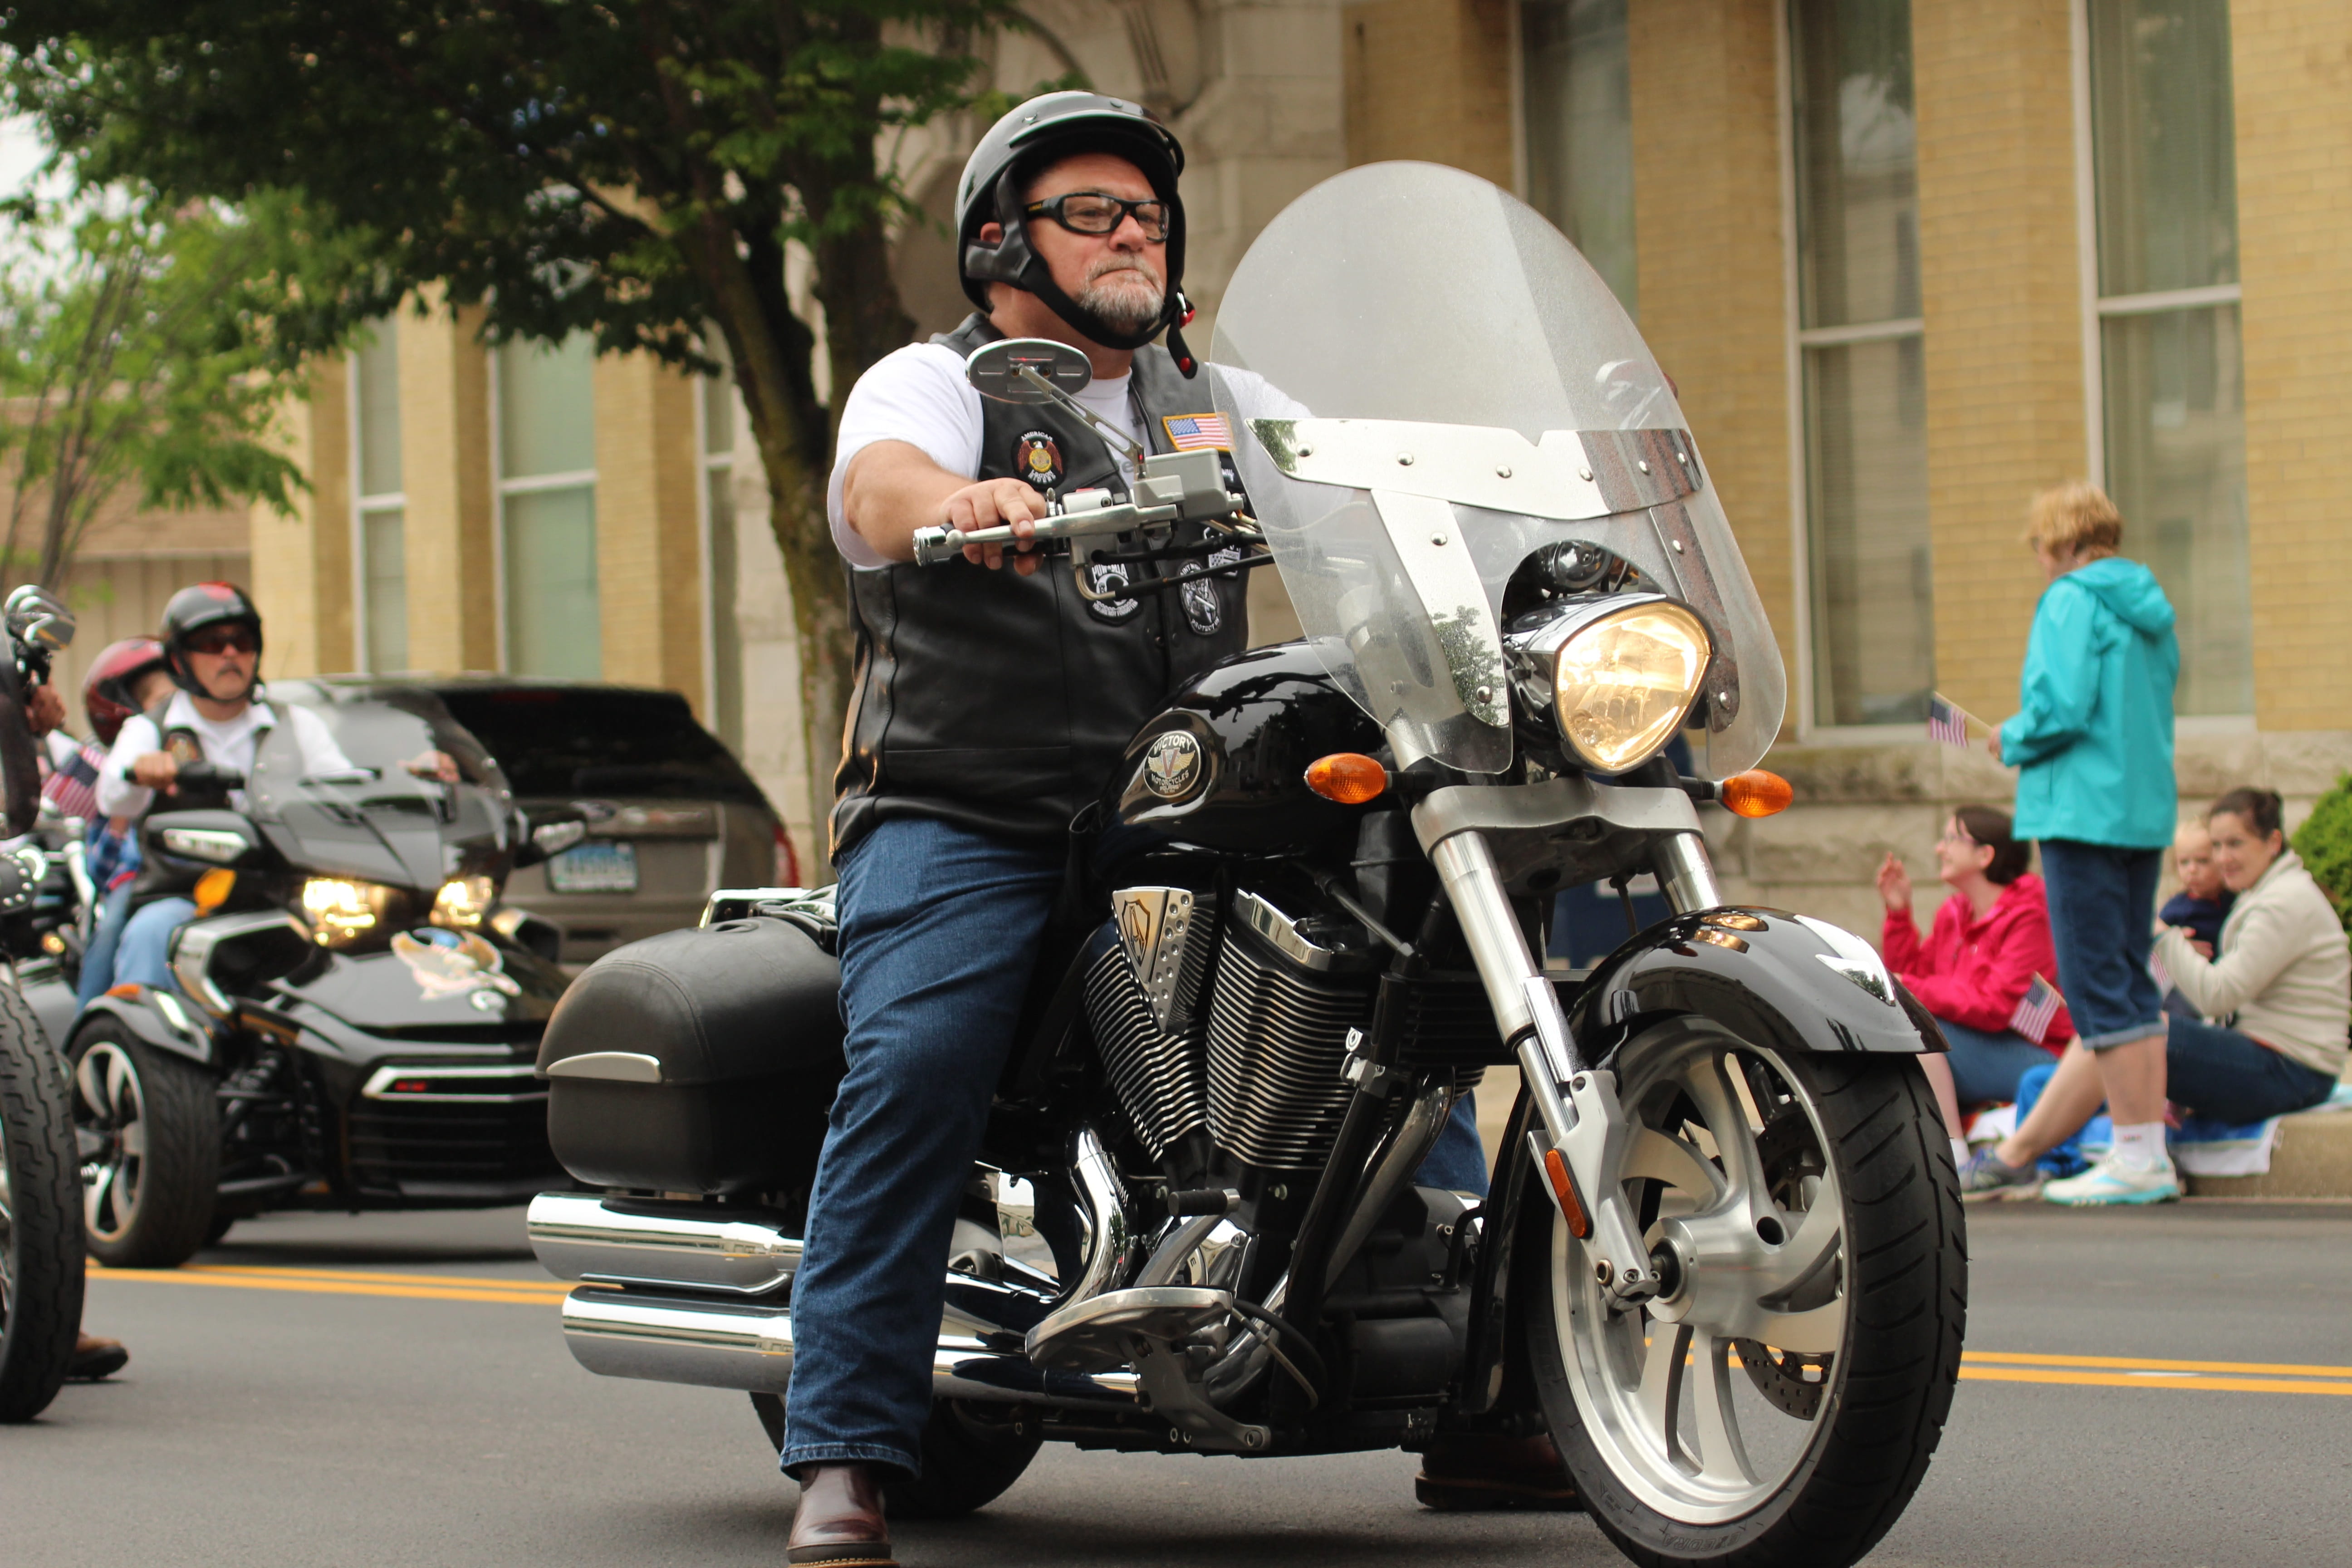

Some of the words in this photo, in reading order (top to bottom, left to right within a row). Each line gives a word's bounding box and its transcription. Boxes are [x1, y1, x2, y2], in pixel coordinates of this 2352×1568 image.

[1021, 431, 1054, 442] AMERICAN
[1030, 469, 1054, 479] LEGION
[1191, 618, 1215, 632] PROTECT
[1153, 735, 1192, 755] VICTORY
[1151, 769, 1190, 786] MOTORCYCLES
